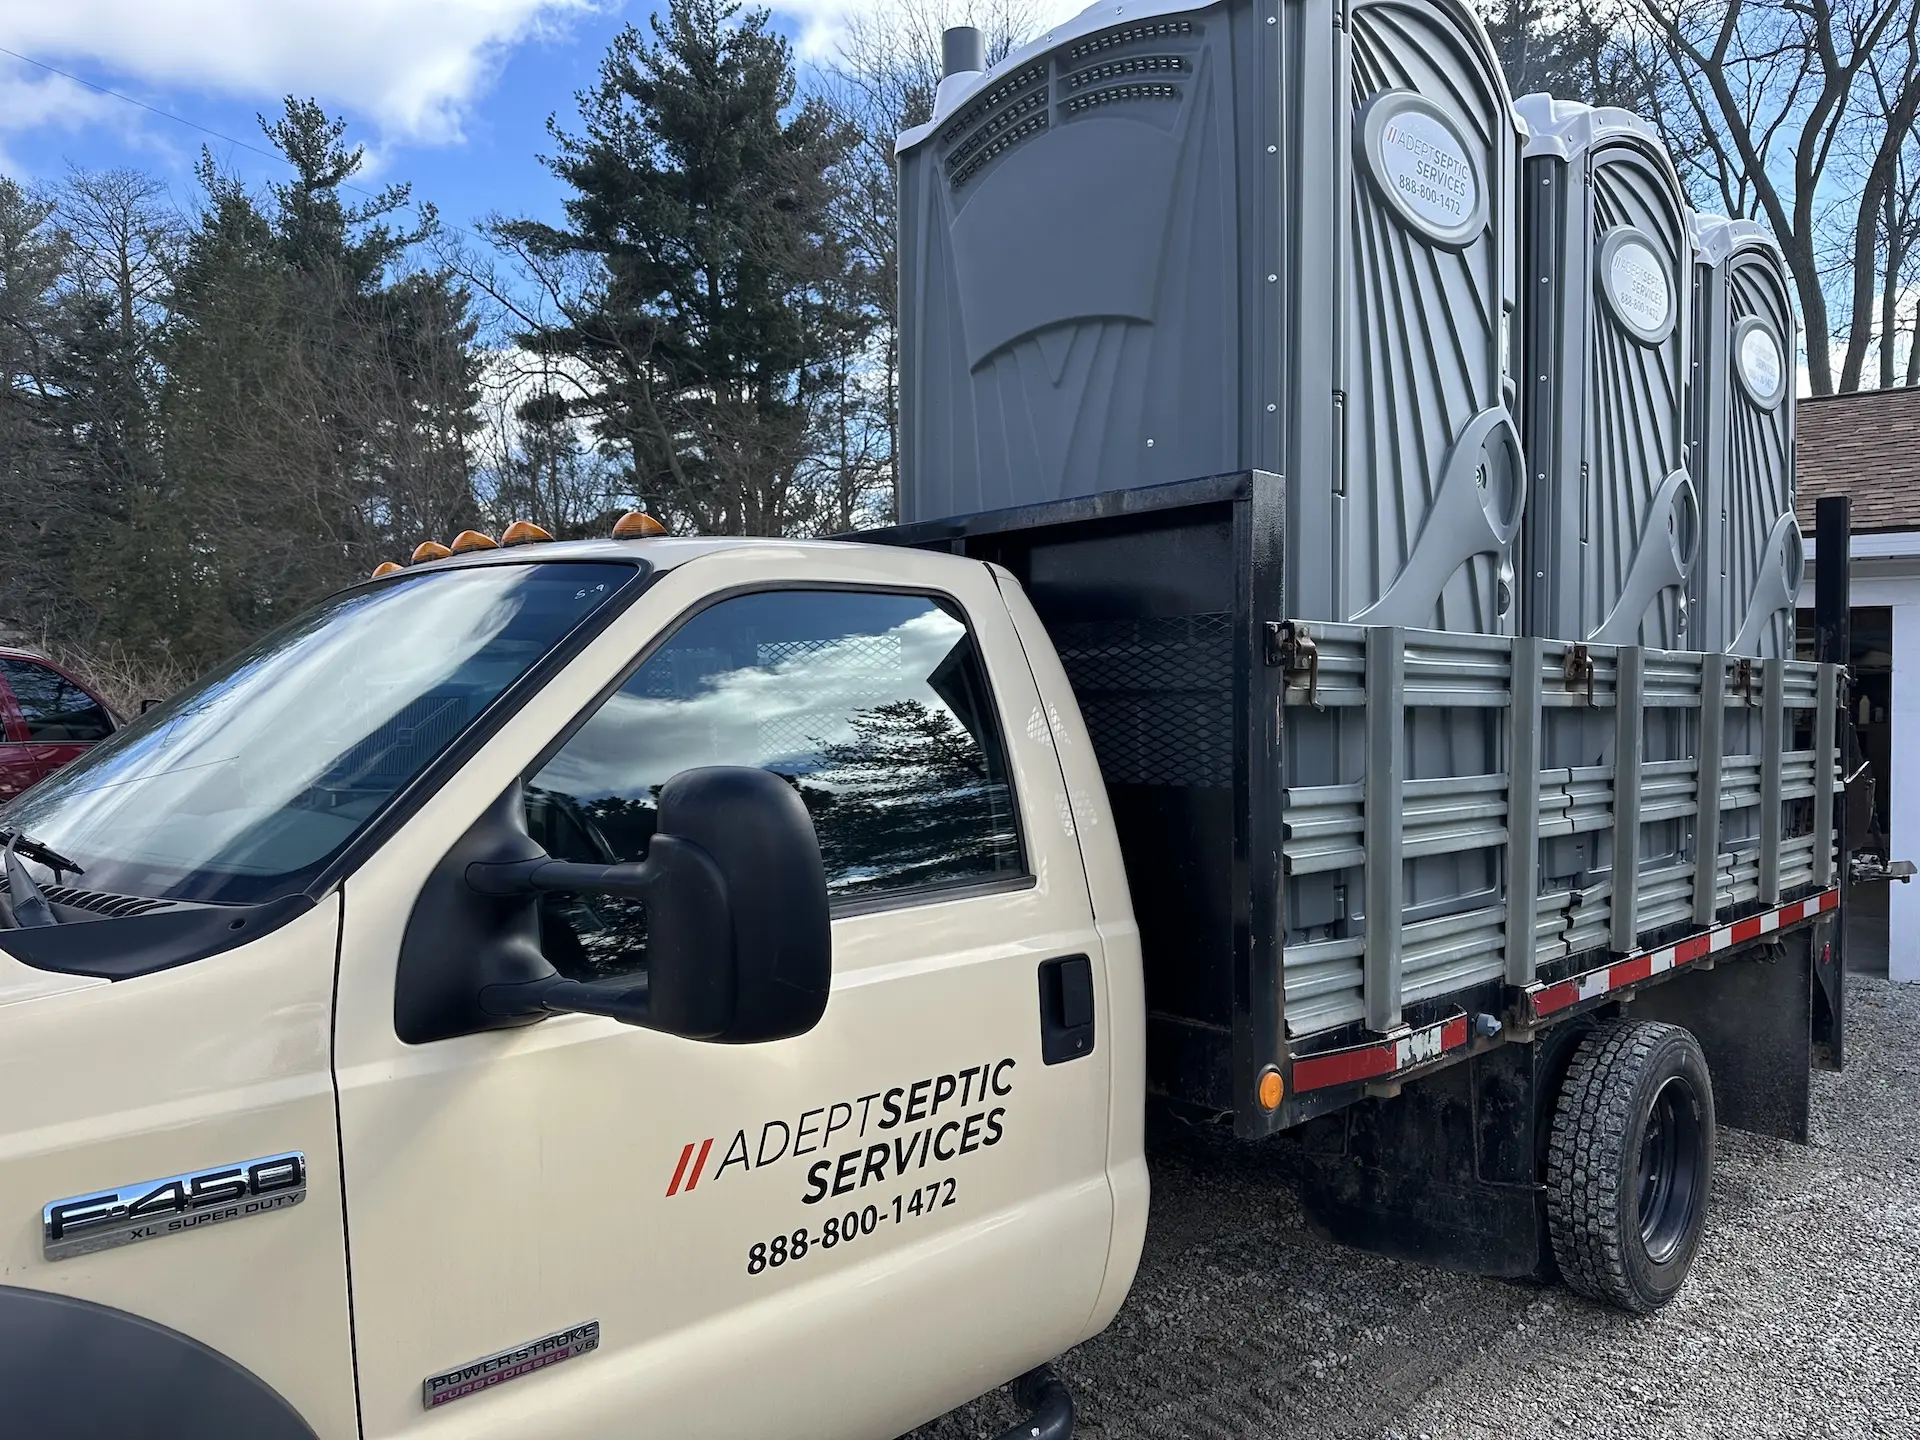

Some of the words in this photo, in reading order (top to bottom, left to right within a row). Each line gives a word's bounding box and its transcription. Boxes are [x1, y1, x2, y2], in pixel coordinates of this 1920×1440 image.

[1399, 174, 1461, 216] 888-800-1472
[1416, 160, 1466, 197] SERVICES
[1632, 280, 1663, 306] SERVICES
[801, 1108, 1006, 1204] SERVICES
[50, 1156, 302, 1241] F-450
[130, 1227, 157, 1240] XL
[168, 1208, 238, 1232] SUPER
[245, 1192, 301, 1213] DUTY
[747, 1177, 957, 1275] 888-800-1472
[435, 1375, 498, 1403] TURBO
[503, 1351, 568, 1380] DIESEL
[574, 1339, 596, 1353] V8
